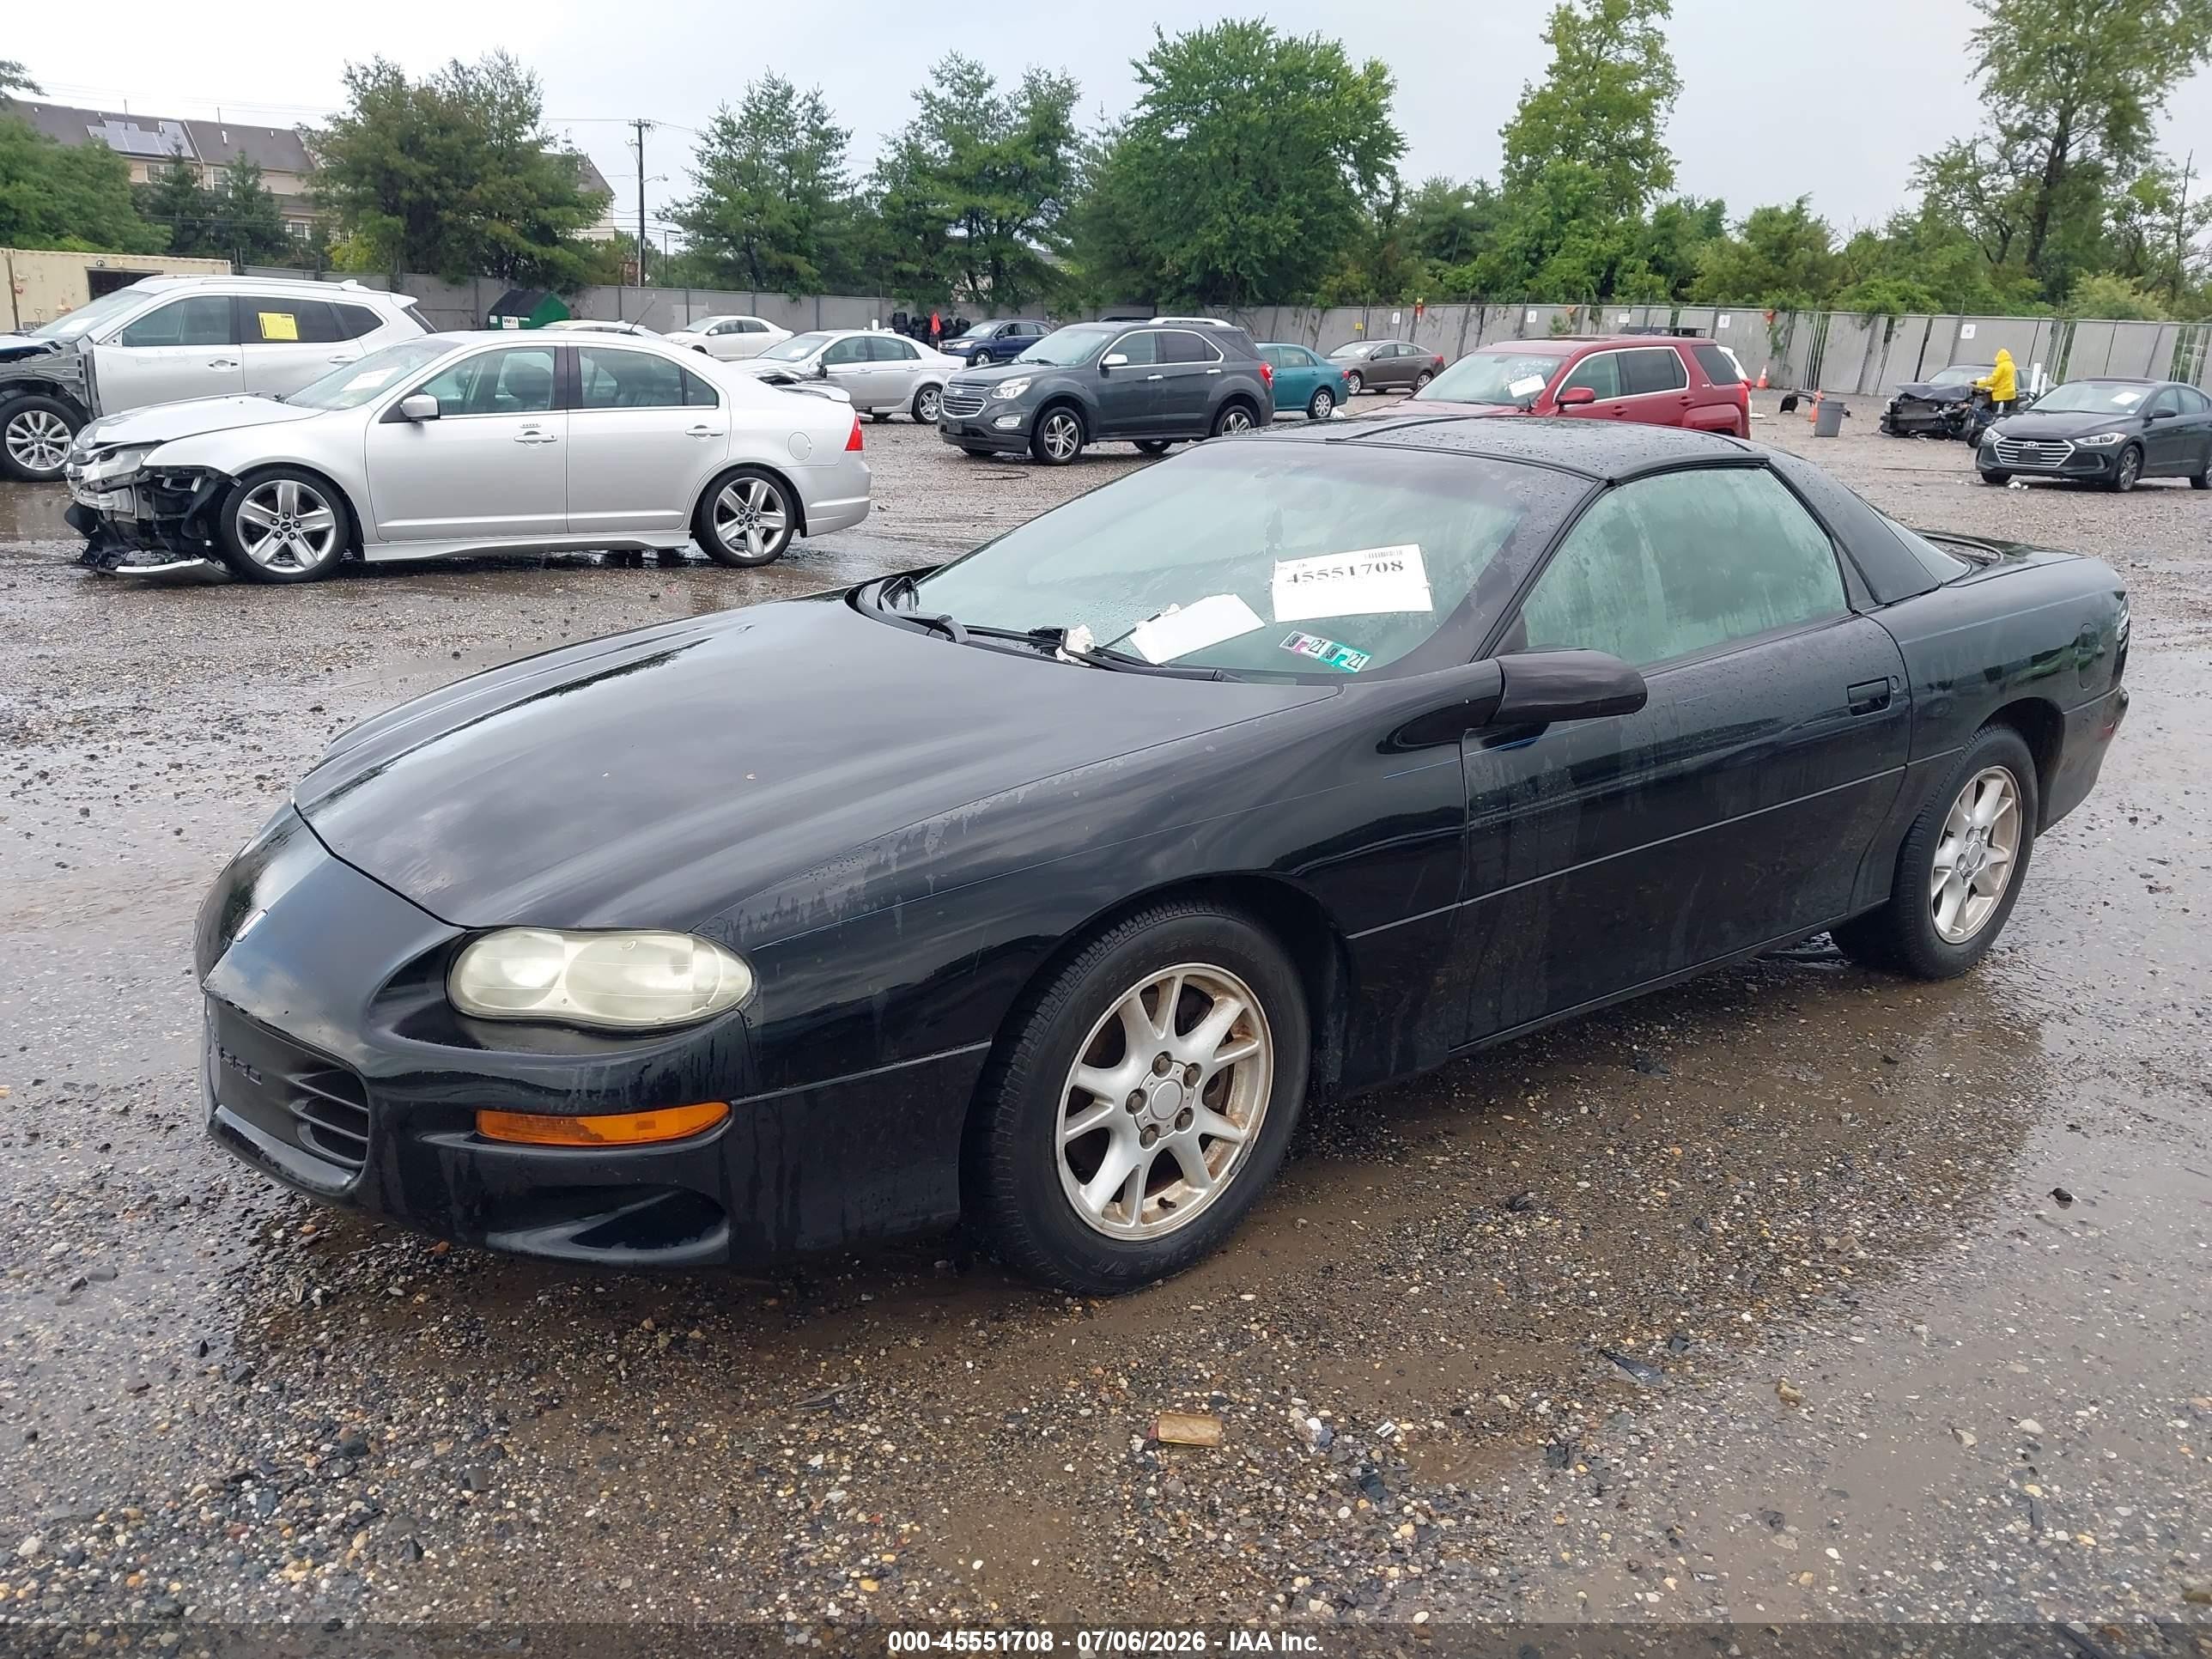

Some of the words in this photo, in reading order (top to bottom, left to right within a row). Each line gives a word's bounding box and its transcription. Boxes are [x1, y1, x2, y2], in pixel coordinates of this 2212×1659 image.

[1286, 560, 1404, 583] 45551708
[1309, 639, 1327, 653] 21
[1347, 653, 1365, 669] 21
